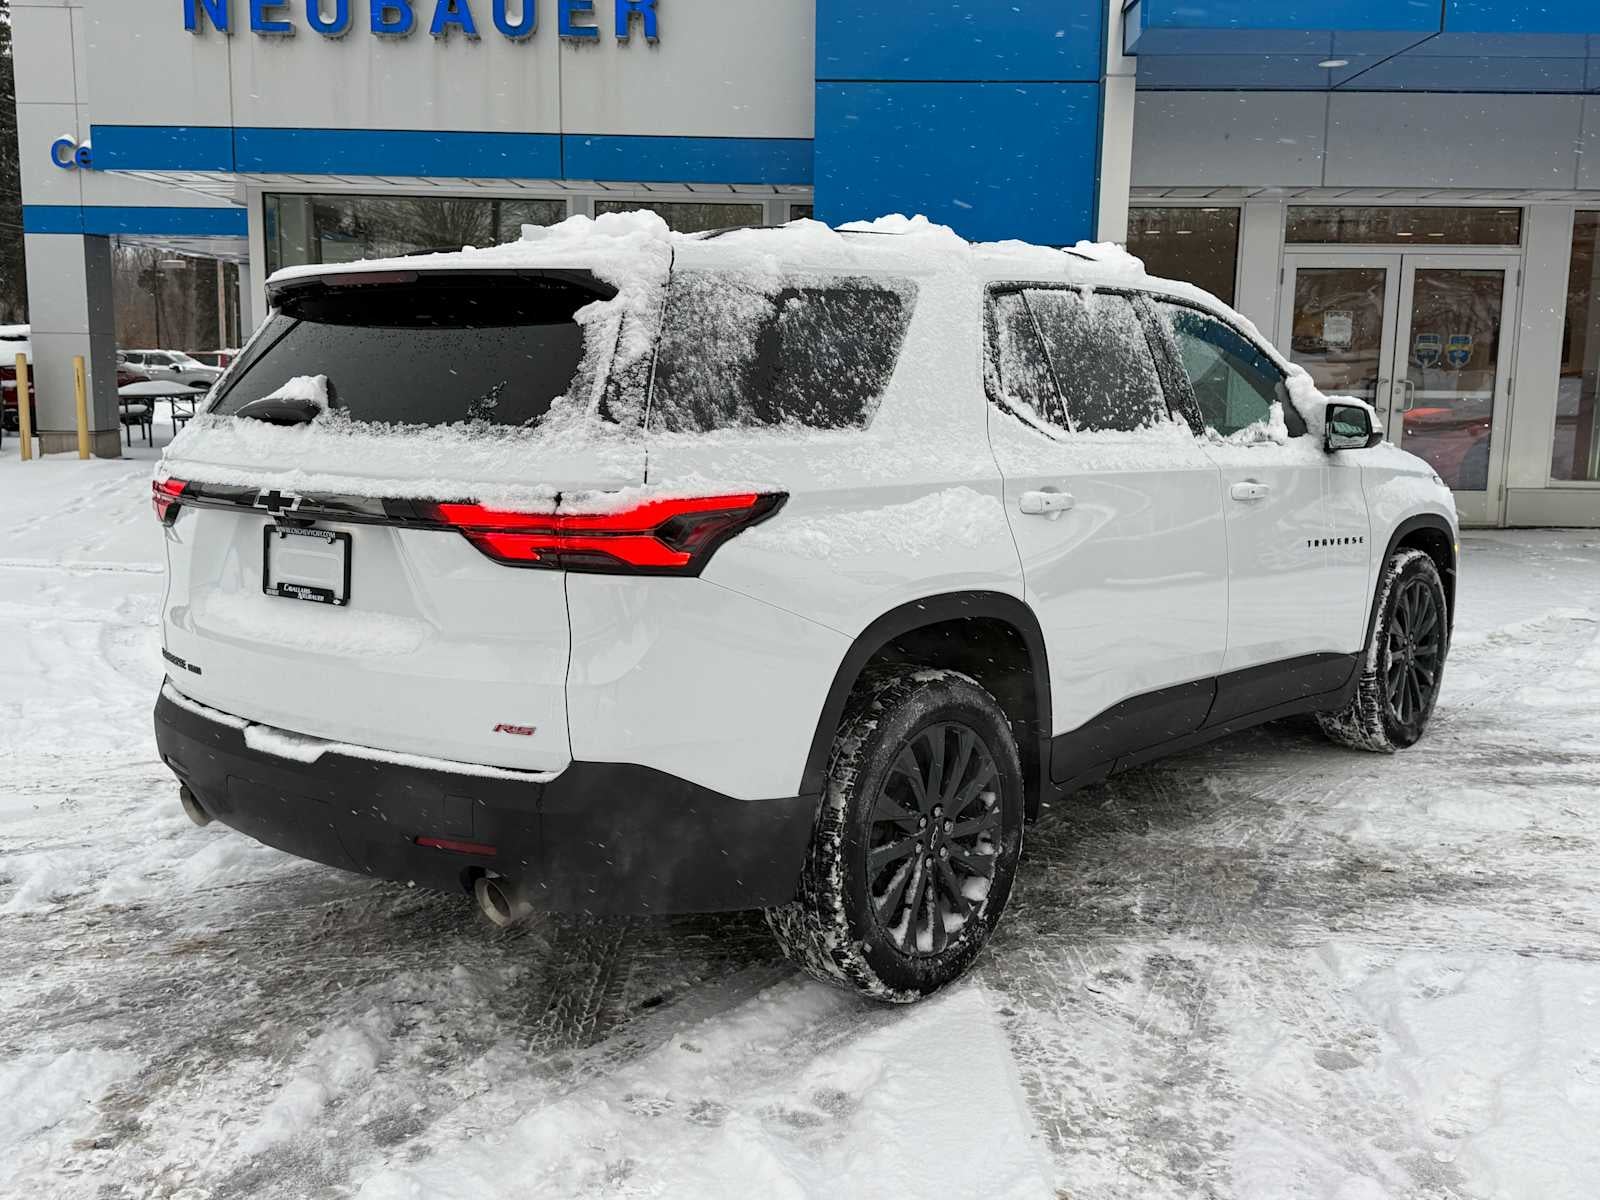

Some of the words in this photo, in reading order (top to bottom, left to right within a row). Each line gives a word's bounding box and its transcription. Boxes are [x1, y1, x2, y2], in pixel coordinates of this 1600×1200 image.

[184, 0, 658, 41] NEUBAUER
[1307, 536, 1364, 548] TRAVERSE
[493, 723, 536, 736] RS
